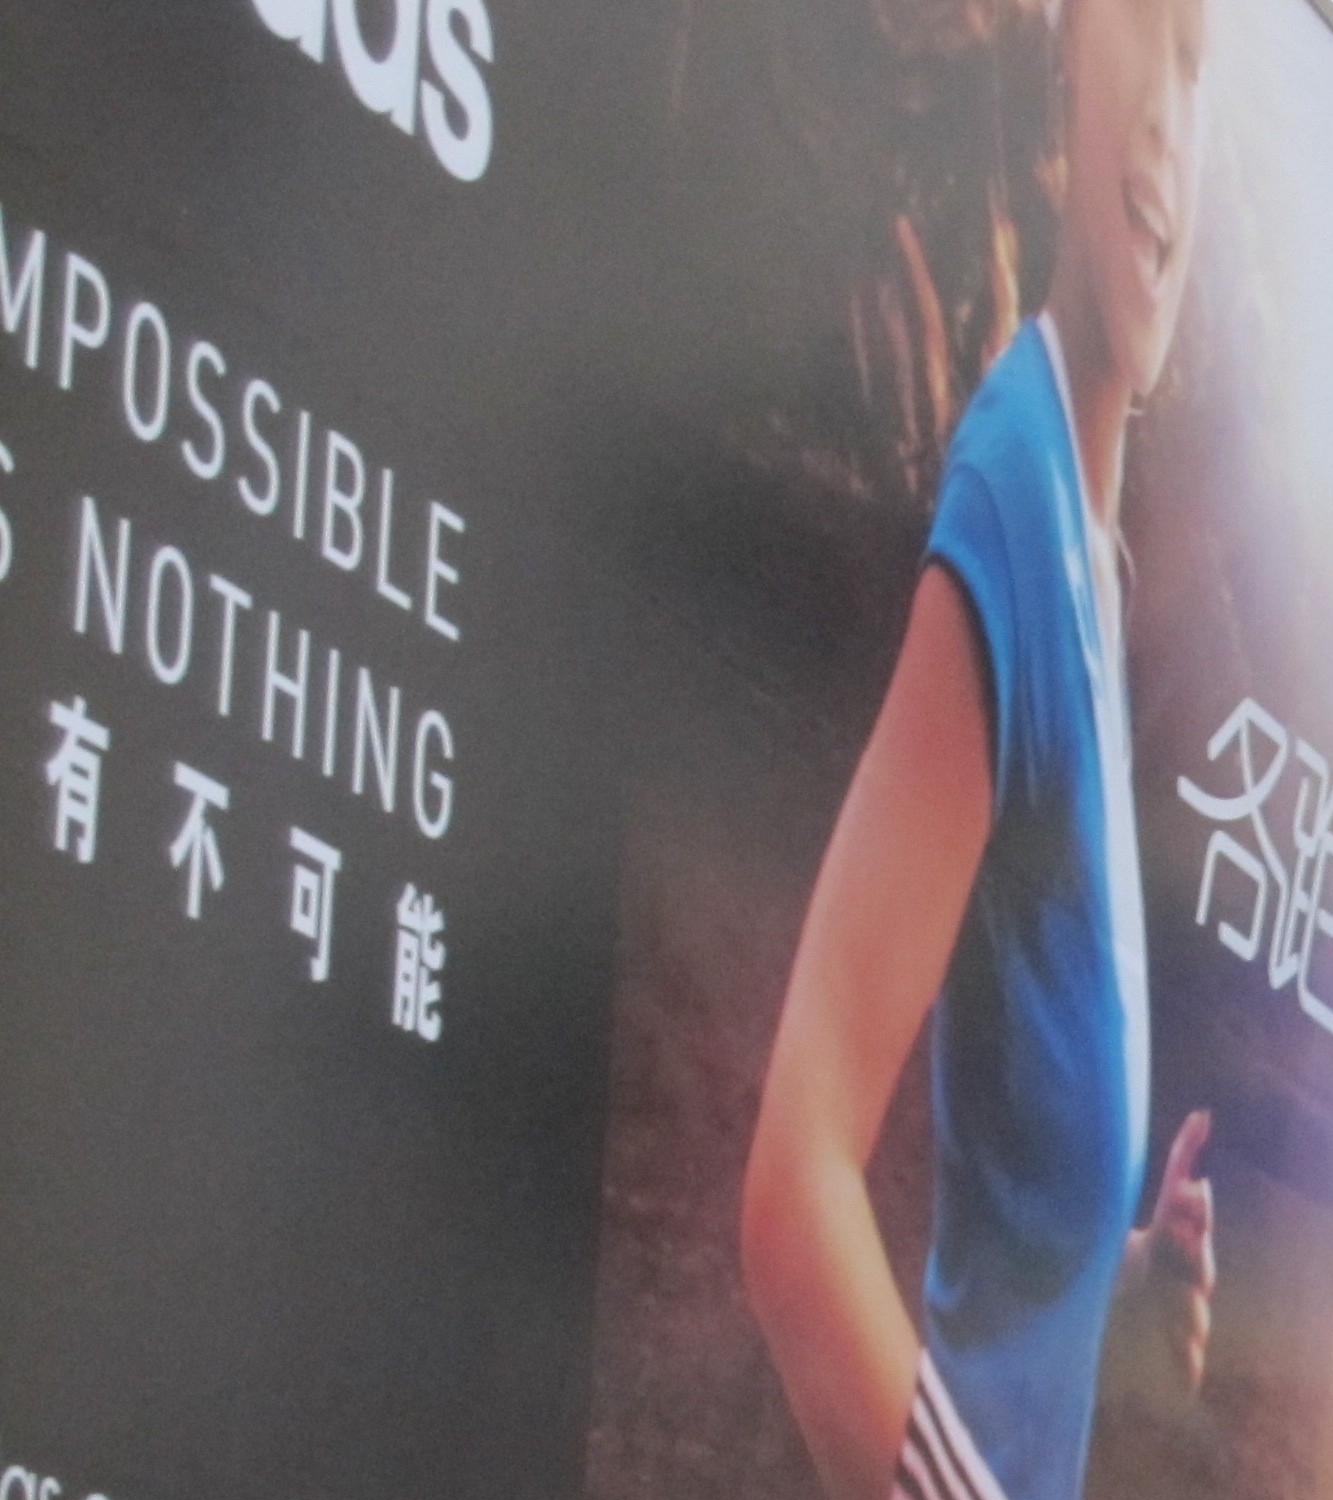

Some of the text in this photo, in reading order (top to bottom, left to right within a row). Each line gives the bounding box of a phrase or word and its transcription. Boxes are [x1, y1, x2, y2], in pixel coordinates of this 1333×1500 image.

[74, 496, 455, 840] NOTHING
[45, 695, 446, 1043] 有不可能
